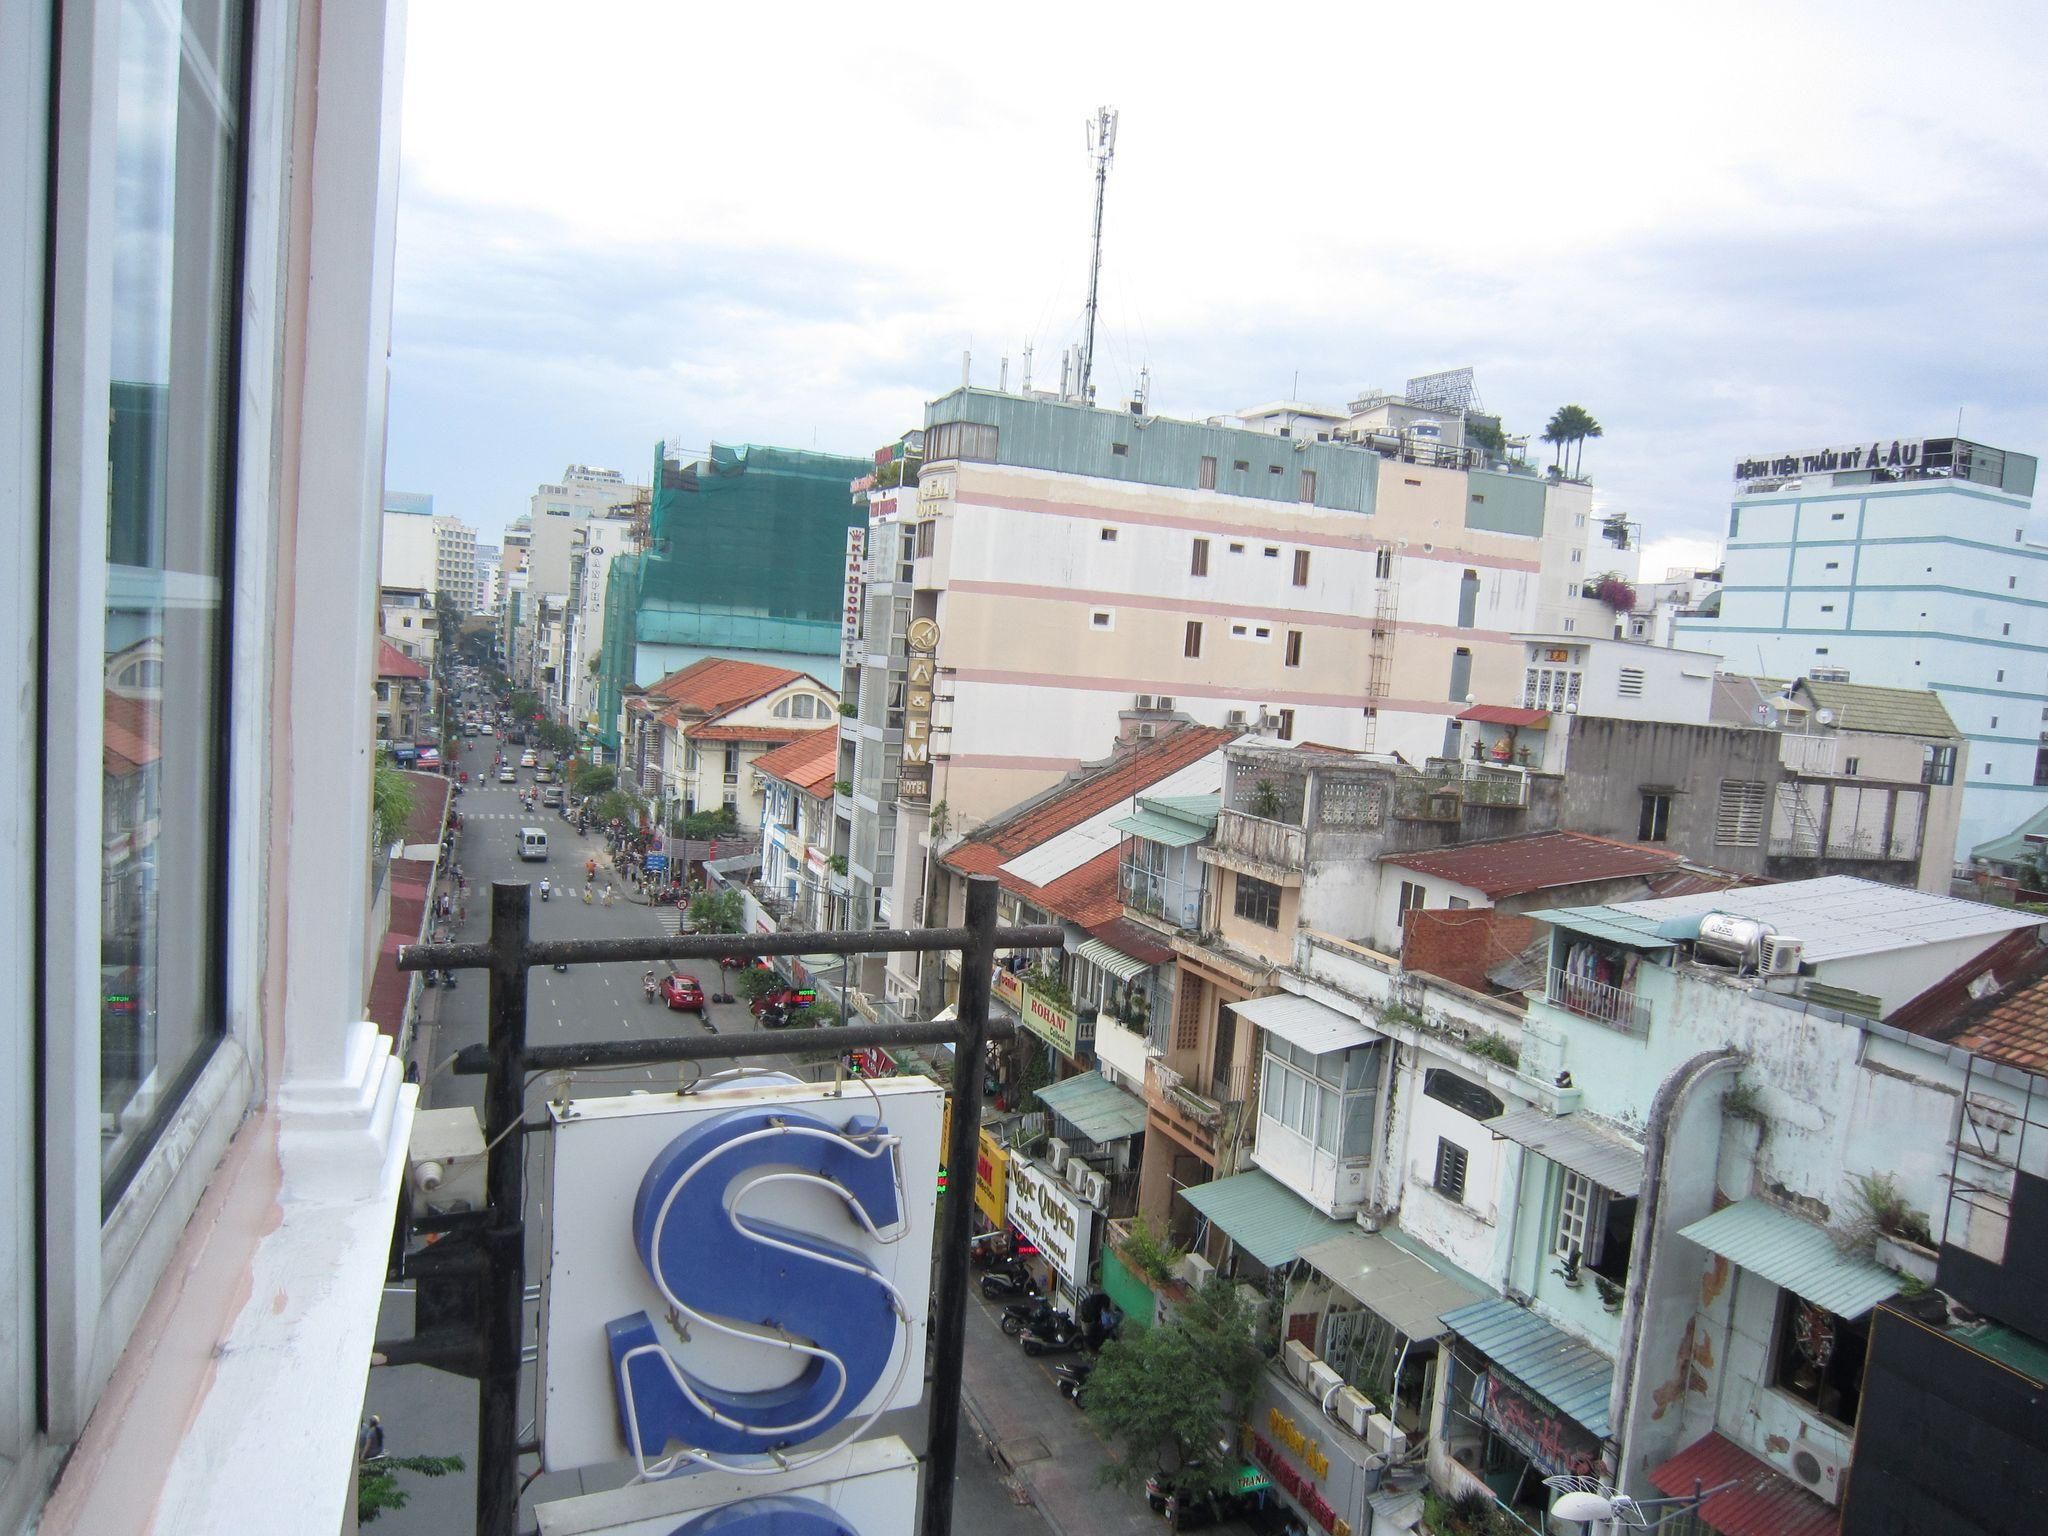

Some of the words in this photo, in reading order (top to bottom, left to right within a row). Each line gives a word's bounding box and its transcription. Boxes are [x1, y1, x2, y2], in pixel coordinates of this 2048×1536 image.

[848, 543, 861, 572] KIM
[899, 778, 928, 795] HOTEL
[1030, 999, 1067, 1034] ROHANI
